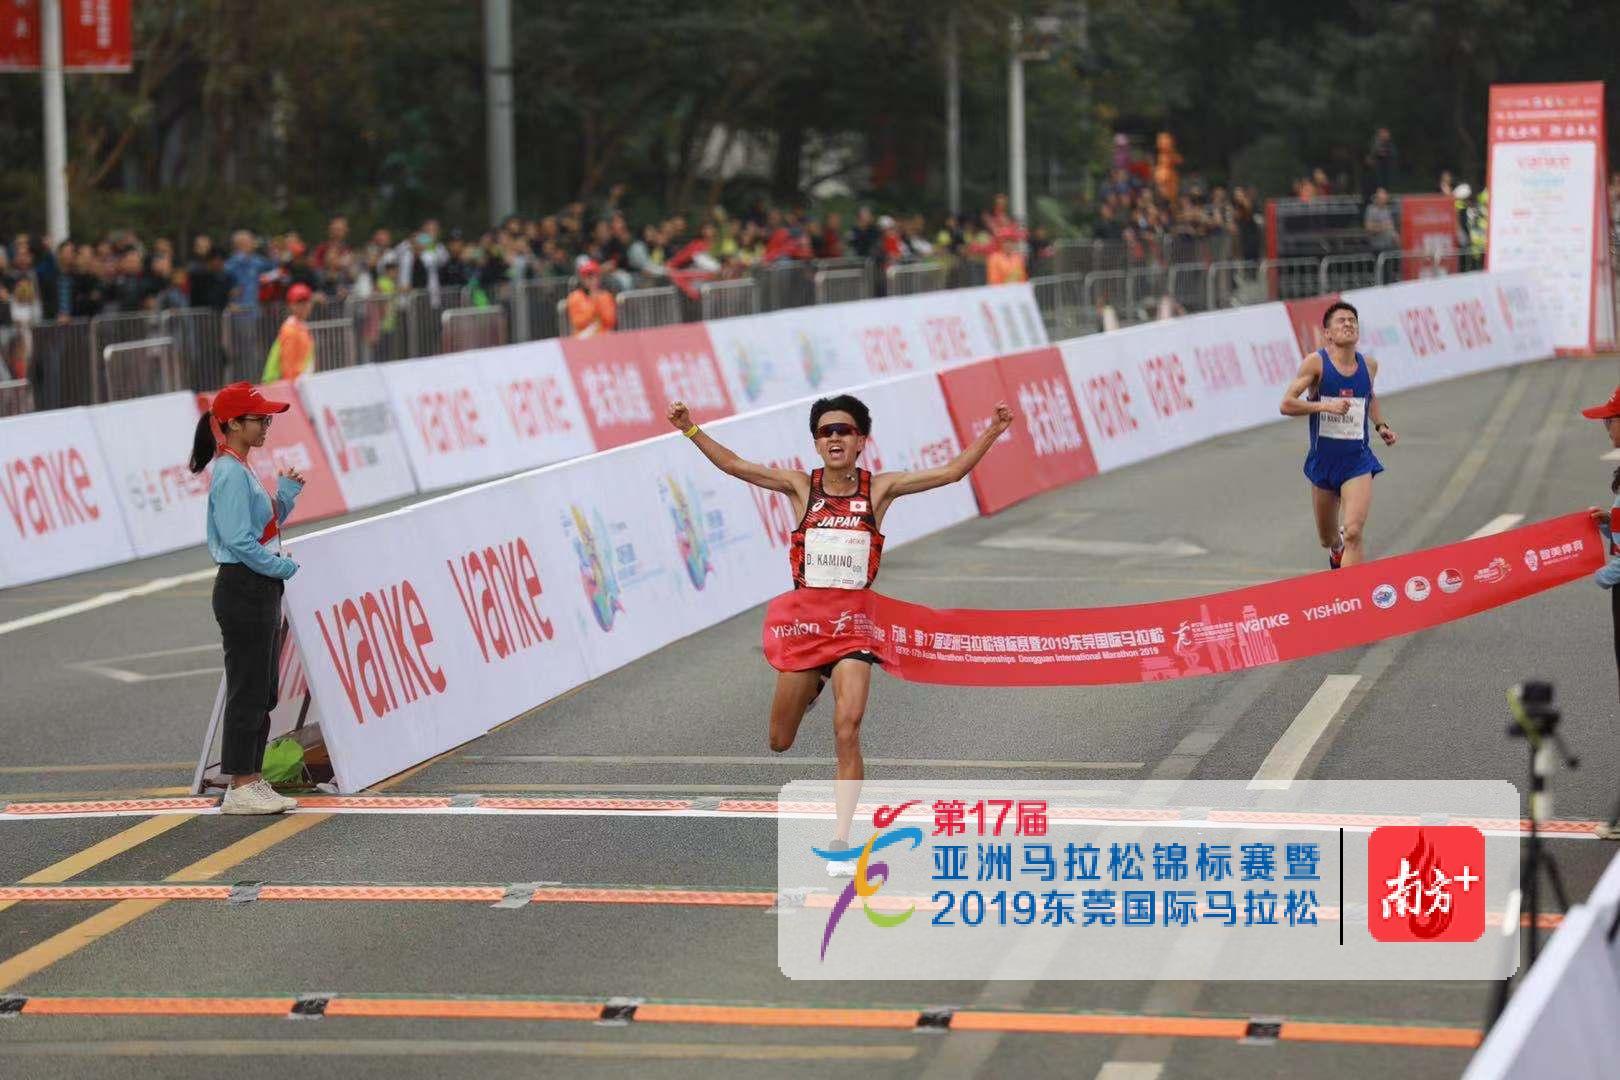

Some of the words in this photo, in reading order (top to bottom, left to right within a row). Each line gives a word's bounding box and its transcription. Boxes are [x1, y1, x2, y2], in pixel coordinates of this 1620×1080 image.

[0, 448, 99, 540] vanke
[817, 515, 861, 527] JAPAN
[817, 553, 853, 568] KAMINO
[446, 536, 554, 663] vanke
[1240, 613, 1290, 633] vanke
[314, 579, 447, 724] vanke
[964, 653, 1016, 664] Championships
[1018, 653, 1054, 664] Dongguan
[1056, 651, 1101, 662] International
[1102, 649, 1138, 659] Marathon
[1140, 647, 1159, 656] 2019
